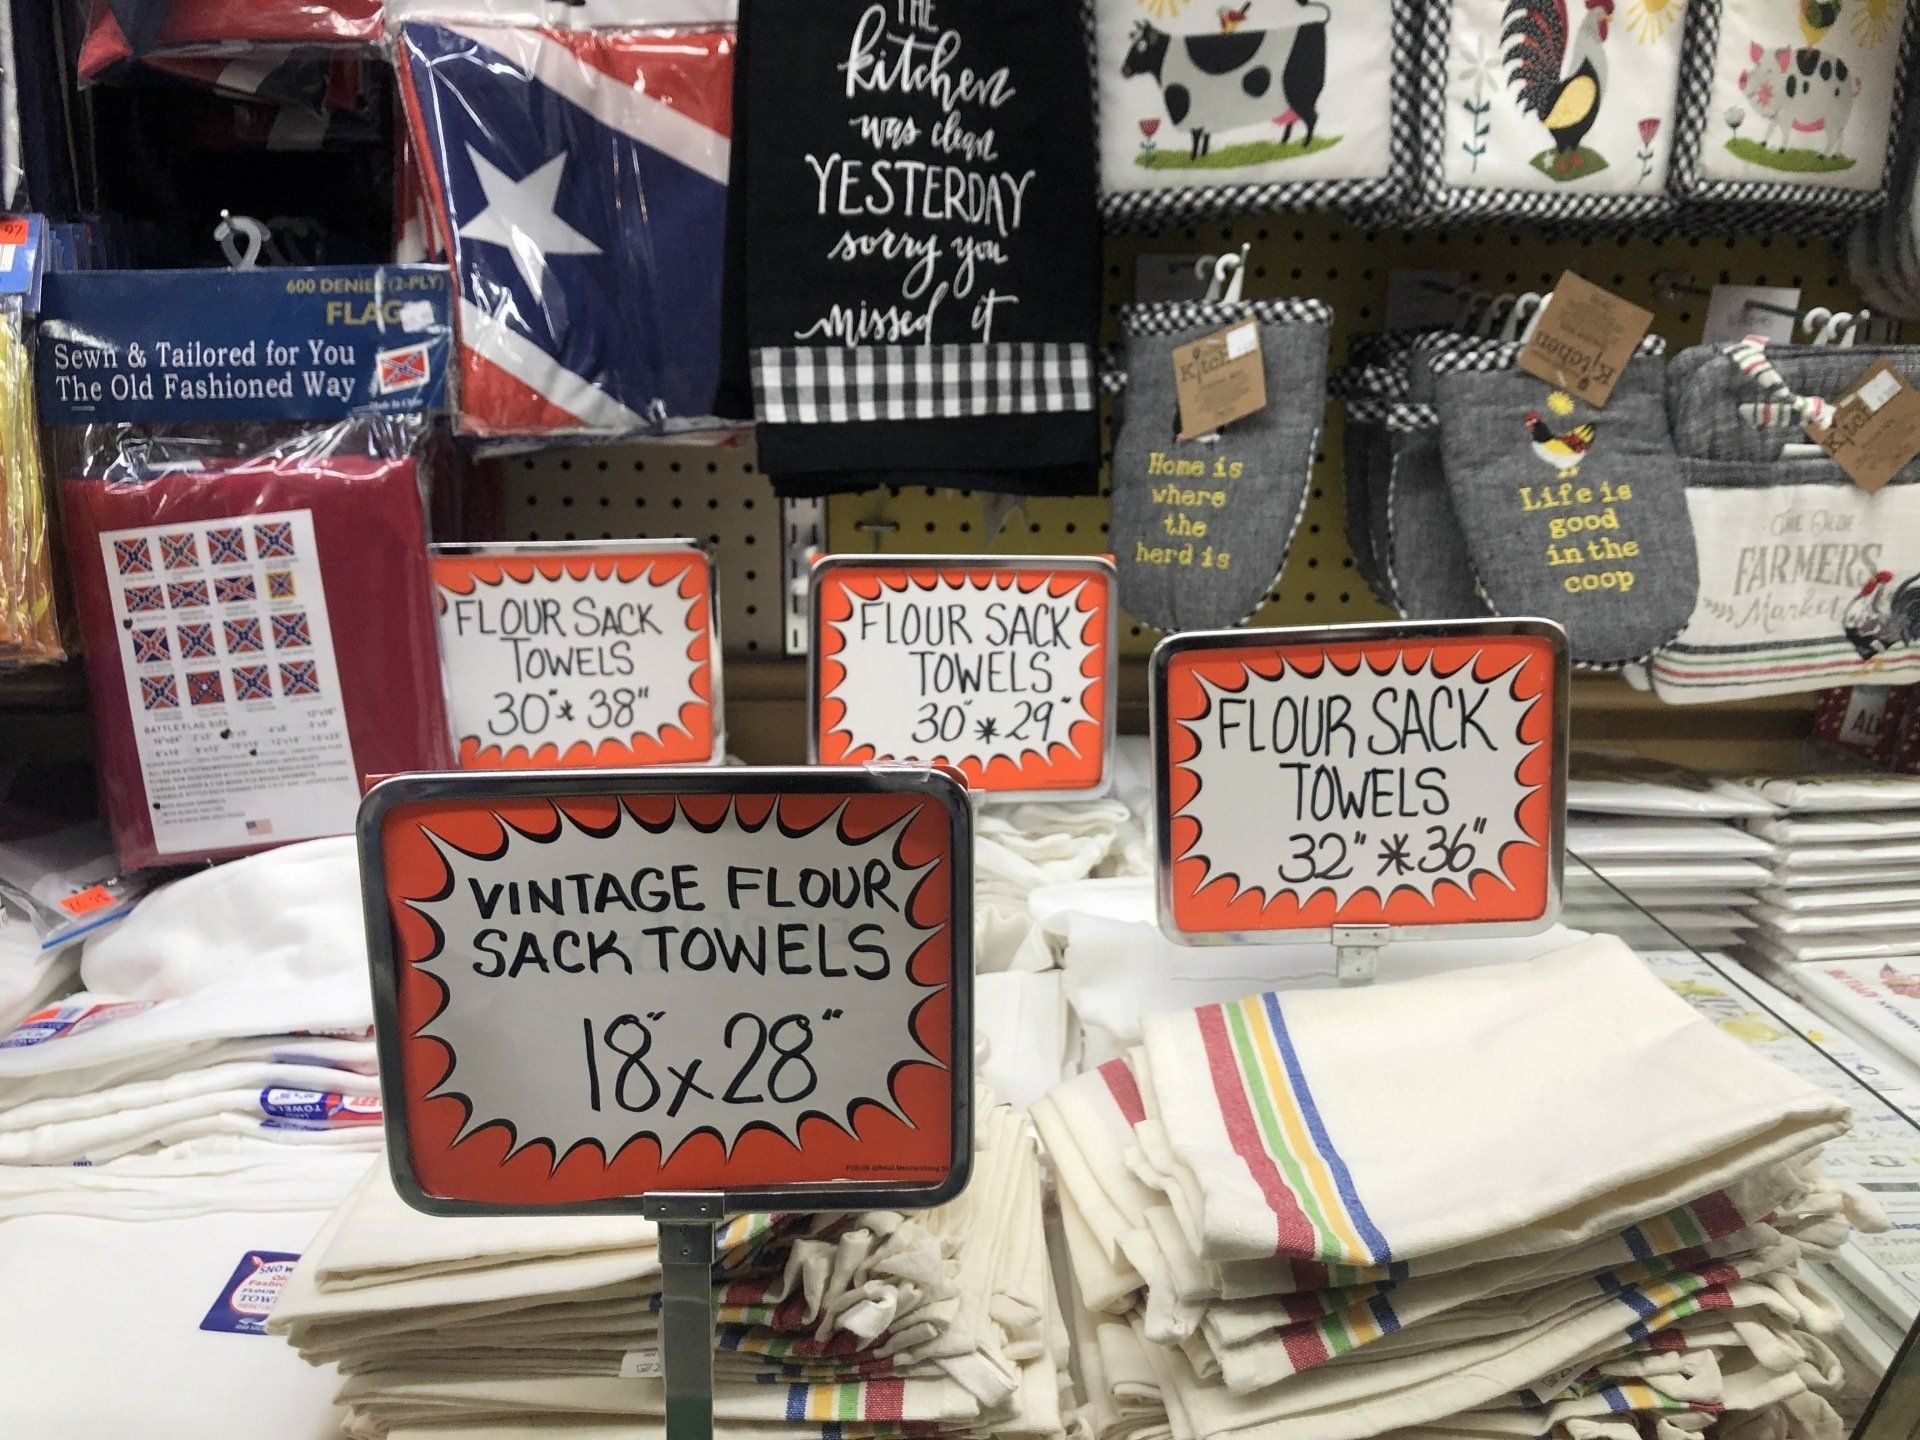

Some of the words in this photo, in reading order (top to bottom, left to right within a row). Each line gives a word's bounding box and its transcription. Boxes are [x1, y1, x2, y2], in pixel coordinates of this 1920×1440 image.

[898, 0, 939, 31] THE
[837, 4, 1016, 111] kitchen
[850, 114, 922, 150] was
[932, 109, 998, 162] clean
[804, 152, 1036, 236] YESTERDAY
[286, 278, 316, 294] 600
[320, 277, 384, 294] DENIE
[827, 227, 942, 299] sorry
[951, 236, 1008, 299] you
[794, 281, 949, 348] missed
[971, 289, 1019, 344] it
[54, 344, 118, 370] Sewn
[127, 341, 147, 368] &
[155, 340, 256, 368] Tailored
[266, 339, 300, 366] for
[306, 339, 356, 366] You
[56, 374, 102, 401] The
[111, 373, 154, 401] Old
[163, 370, 293, 400] Fashioned
[302, 370, 356, 403] Way
[1147, 452, 1205, 477] Home
[1212, 456, 1243, 479] is
[1151, 483, 1226, 508] where
[1519, 482, 1593, 511] Life
[1600, 480, 1633, 503] is
[1163, 513, 1207, 537] the
[1548, 507, 1620, 539] good
[1135, 541, 1193, 566] herd
[1201, 545, 1230, 569] is
[1546, 543, 1584, 567] in
[1587, 536, 1639, 561] the
[1733, 543, 1883, 596] FARMERS
[1564, 571, 1635, 593] coop
[456, 598, 566, 637] FLOUR
[573, 596, 663, 636] SACK
[861, 601, 973, 646] FLOUR
[985, 602, 1071, 650] SACK
[1735, 592, 1840, 634] Market
[500, 637, 634, 683] TOWELS
[909, 651, 1052, 696] TOWELS
[488, 687, 558, 736] 30"
[587, 686, 650, 729] 38"
[911, 698, 974, 744] 30"
[1004, 696, 1072, 742] 29"
[1218, 694, 1356, 758] FLOUR
[1368, 685, 1498, 756] SACK
[1279, 762, 1450, 821] TOWELS
[1278, 829, 1367, 883] 32"
[1417, 816, 1488, 873] 36"
[467, 864, 703, 919] VINTAGE
[726, 858, 900, 914] FLOUR
[473, 928, 634, 979] SACK
[641, 922, 893, 981] TOWELS
[582, 1009, 668, 1114] 18"
[667, 1057, 714, 1117] x
[721, 1006, 844, 1105] 28"
